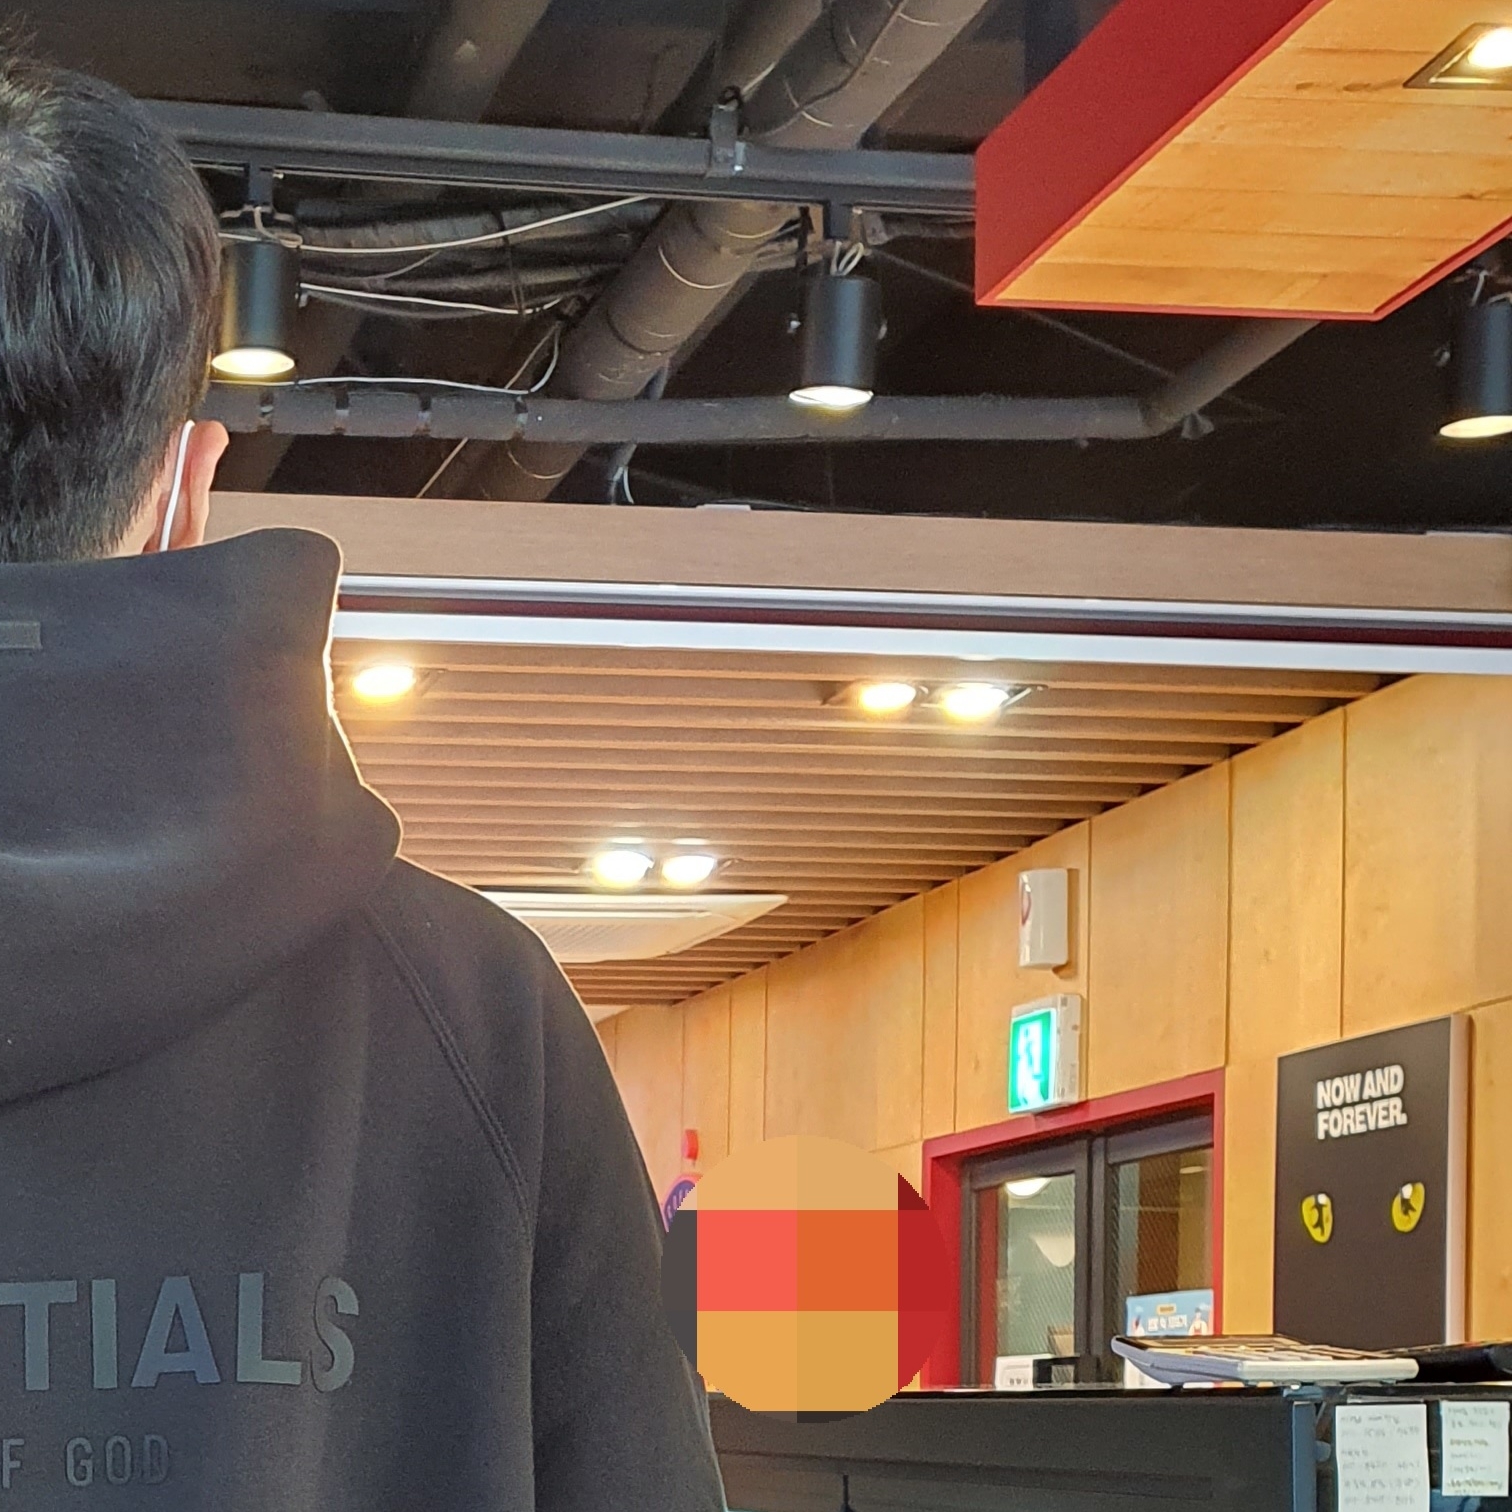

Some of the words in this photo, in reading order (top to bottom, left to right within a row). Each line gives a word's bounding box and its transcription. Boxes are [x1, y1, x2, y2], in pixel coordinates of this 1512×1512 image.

[1316, 1072, 1362, 1109] NOW
[1362, 1064, 1405, 1100] AND
[1317, 1096, 1408, 1140] FOREVER.
[65, 1434, 170, 1488] GOD
